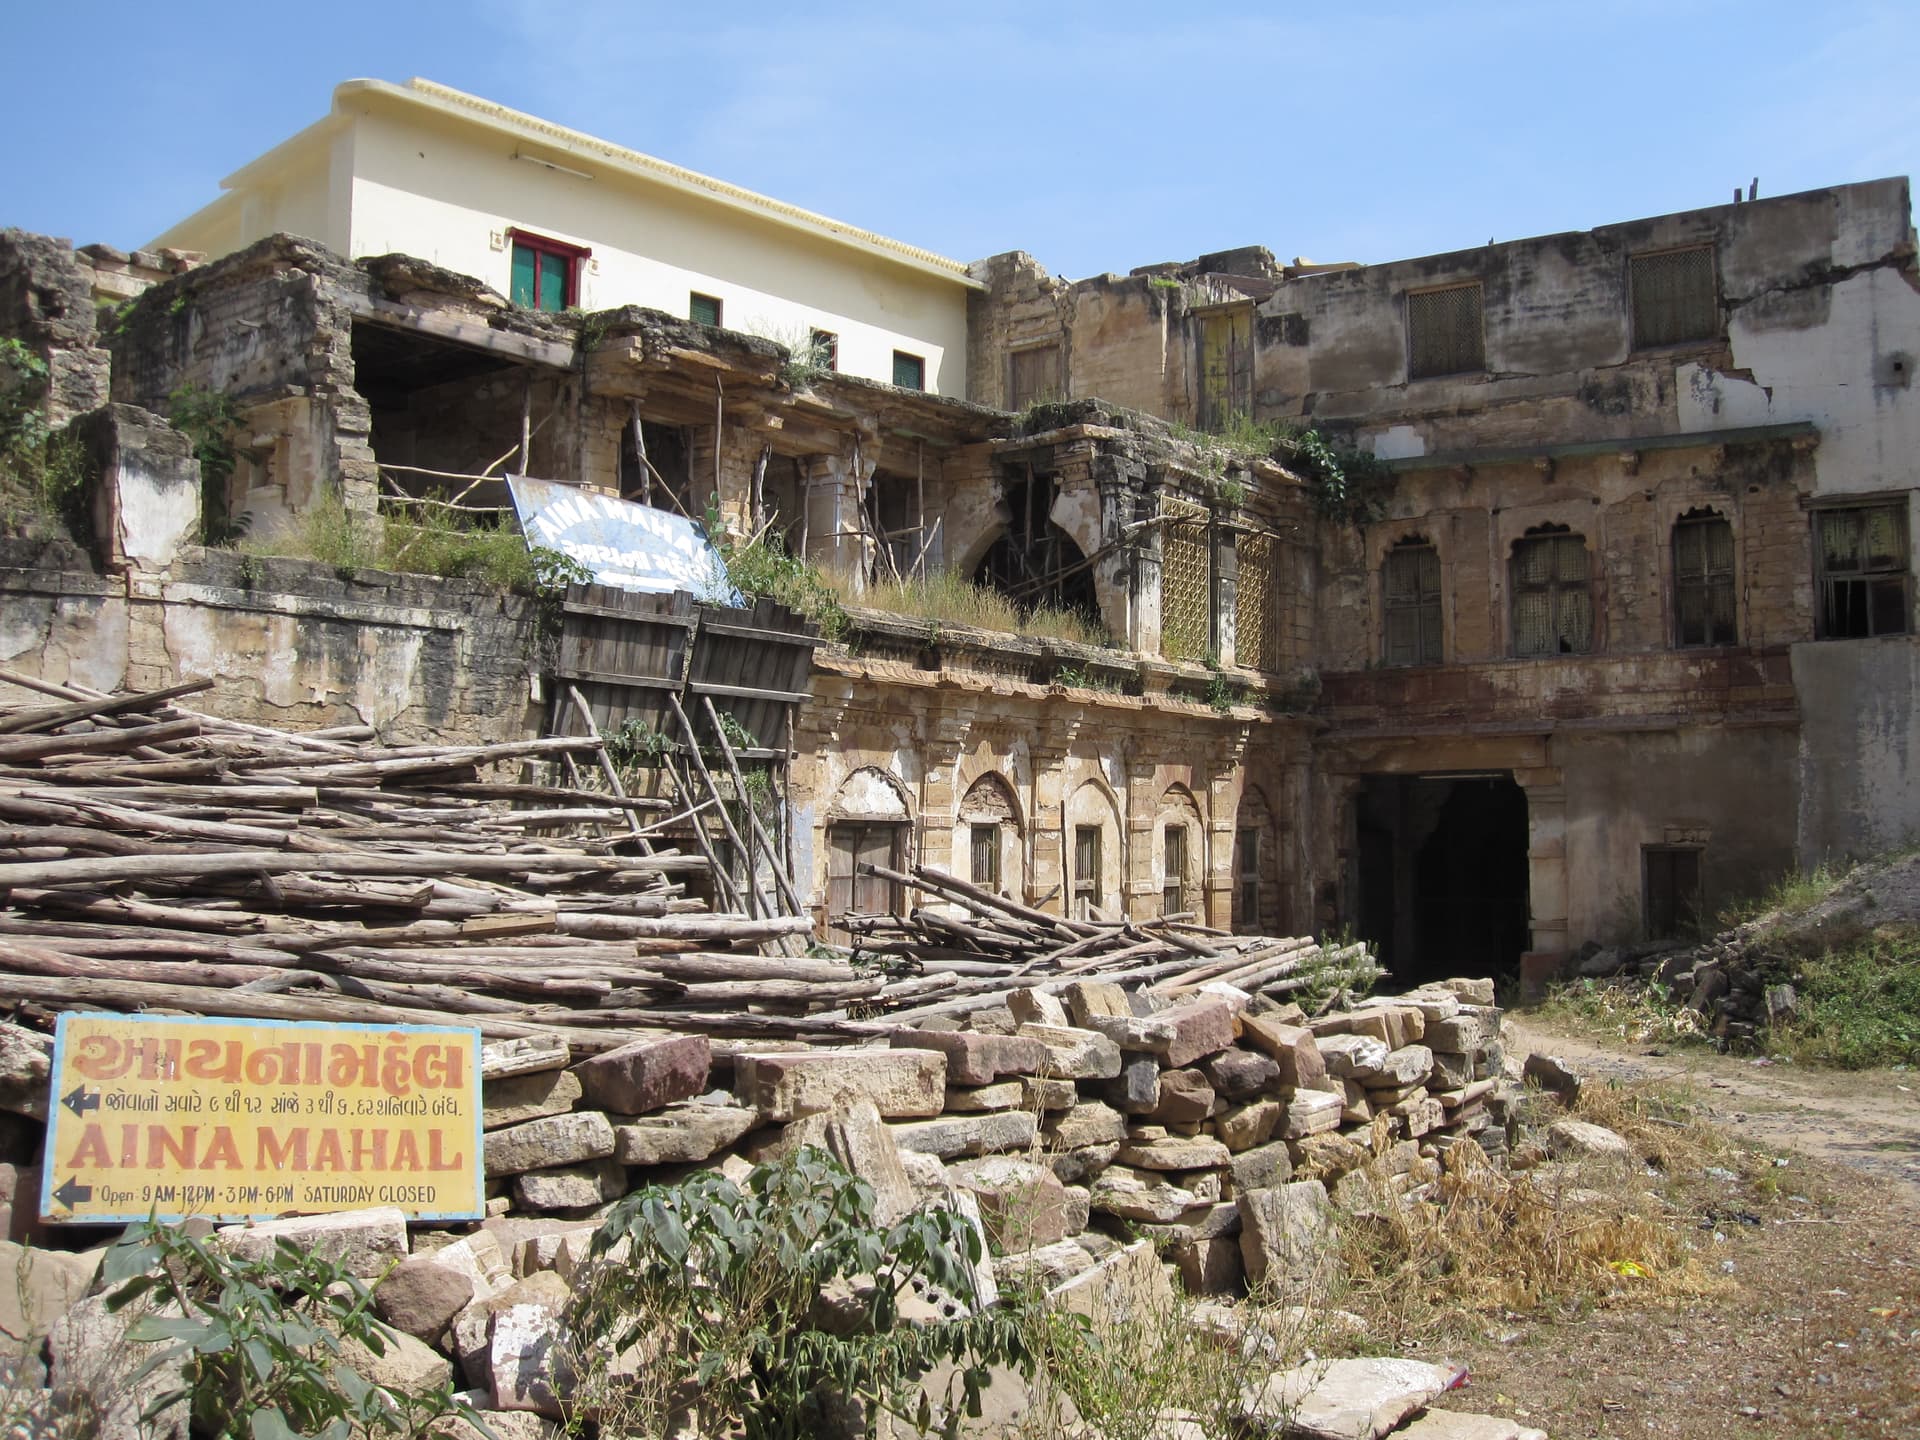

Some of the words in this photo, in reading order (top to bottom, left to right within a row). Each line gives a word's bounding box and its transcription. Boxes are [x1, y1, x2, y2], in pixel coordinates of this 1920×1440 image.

[535, 495, 601, 543] AINA
[597, 496, 712, 571] MAHAL
[165, 1089, 202, 1113] સવારે
[66, 1123, 244, 1170] AINA
[254, 1126, 463, 1172] MAHAL
[101, 1185, 134, 1207] Open
[304, 1185, 375, 1204] SATURDAY
[379, 1186, 437, 1204] CLOSED
